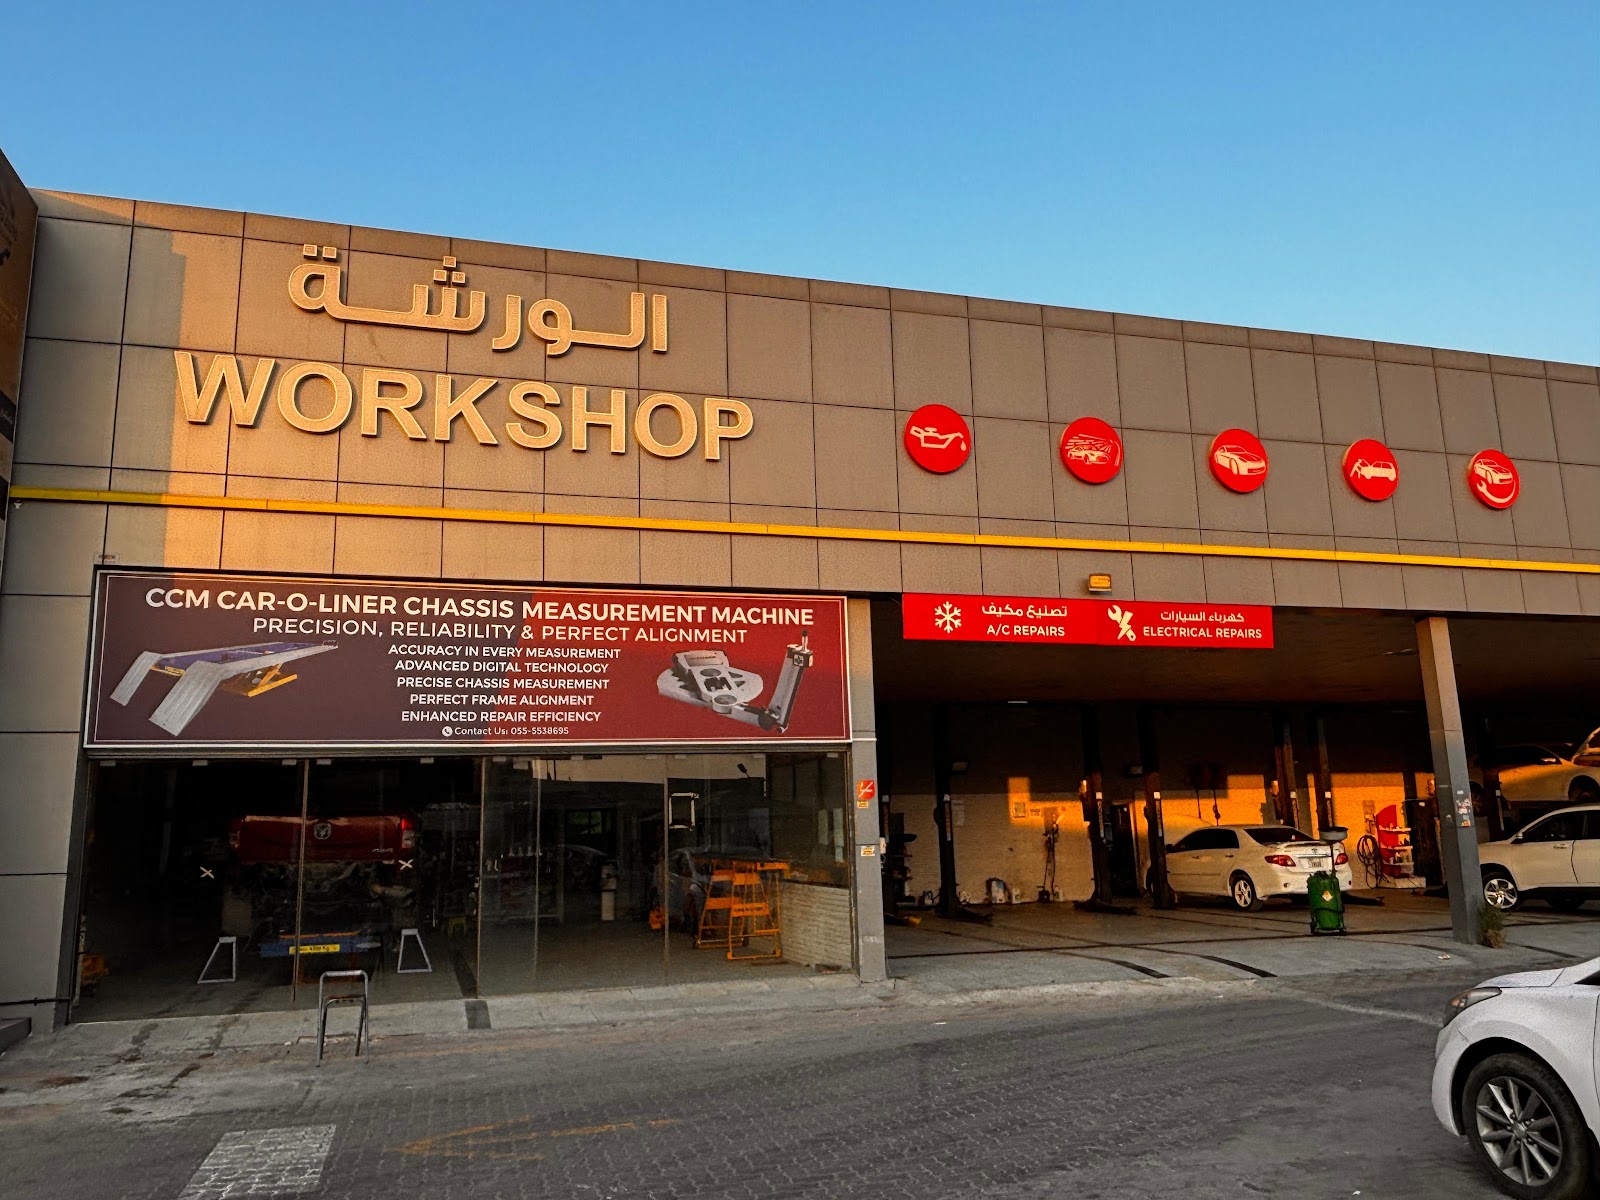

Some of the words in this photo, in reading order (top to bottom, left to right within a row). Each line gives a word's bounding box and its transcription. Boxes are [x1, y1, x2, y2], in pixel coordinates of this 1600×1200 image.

[288, 243, 668, 357] الورشة
[174, 350, 755, 461] WORKSHOP
[145, 588, 210, 608] CCM
[216, 590, 397, 614] CAR-O-LINER
[403, 596, 514, 619] CHASSIS
[522, 601, 707, 624] MEASUREMENT
[711, 606, 814, 626] MACHINE
[1160, 611, 1205, 623] السيارات
[1208, 612, 1244, 624] كهرباء
[253, 618, 384, 637] PRECISION,
[390, 621, 516, 639] RELIABILITY
[520, 625, 534, 640] &
[542, 626, 630, 642] PERFECT
[635, 629, 748, 644] ALIGNMENT
[986, 623, 1010, 636] A/C
[1013, 625, 1065, 637] REPAIRS
[1143, 626, 1212, 638] ELECTRICAL
[1215, 628, 1263, 639] REPAIRS
[388, 645, 462, 656] ACCURACY
[465, 646, 479, 656] IN
[482, 647, 523, 657] EVERY
[526, 648, 621, 659] MEASUREMENT
[394, 660, 470, 672] ADVANCED
[473, 662, 522, 673] DIGITAL
[524, 663, 609, 673] TECHNOLOGY
[397, 677, 453, 688] PRECISE
[455, 678, 510, 689] CHASSIS
[513, 679, 610, 690] MEASUREMENT
[410, 694, 468, 705] PERFECT
[471, 695, 517, 706] FRAME
[519, 695, 595, 706] ALIGNMENT
[401, 711, 477, 722] ENHANCED
[480, 711, 527, 722] REPAIR
[529, 711, 602, 722] EFFICIENCY
[454, 727, 492, 736] Contact
[510, 727, 570, 735] 055-5538695
